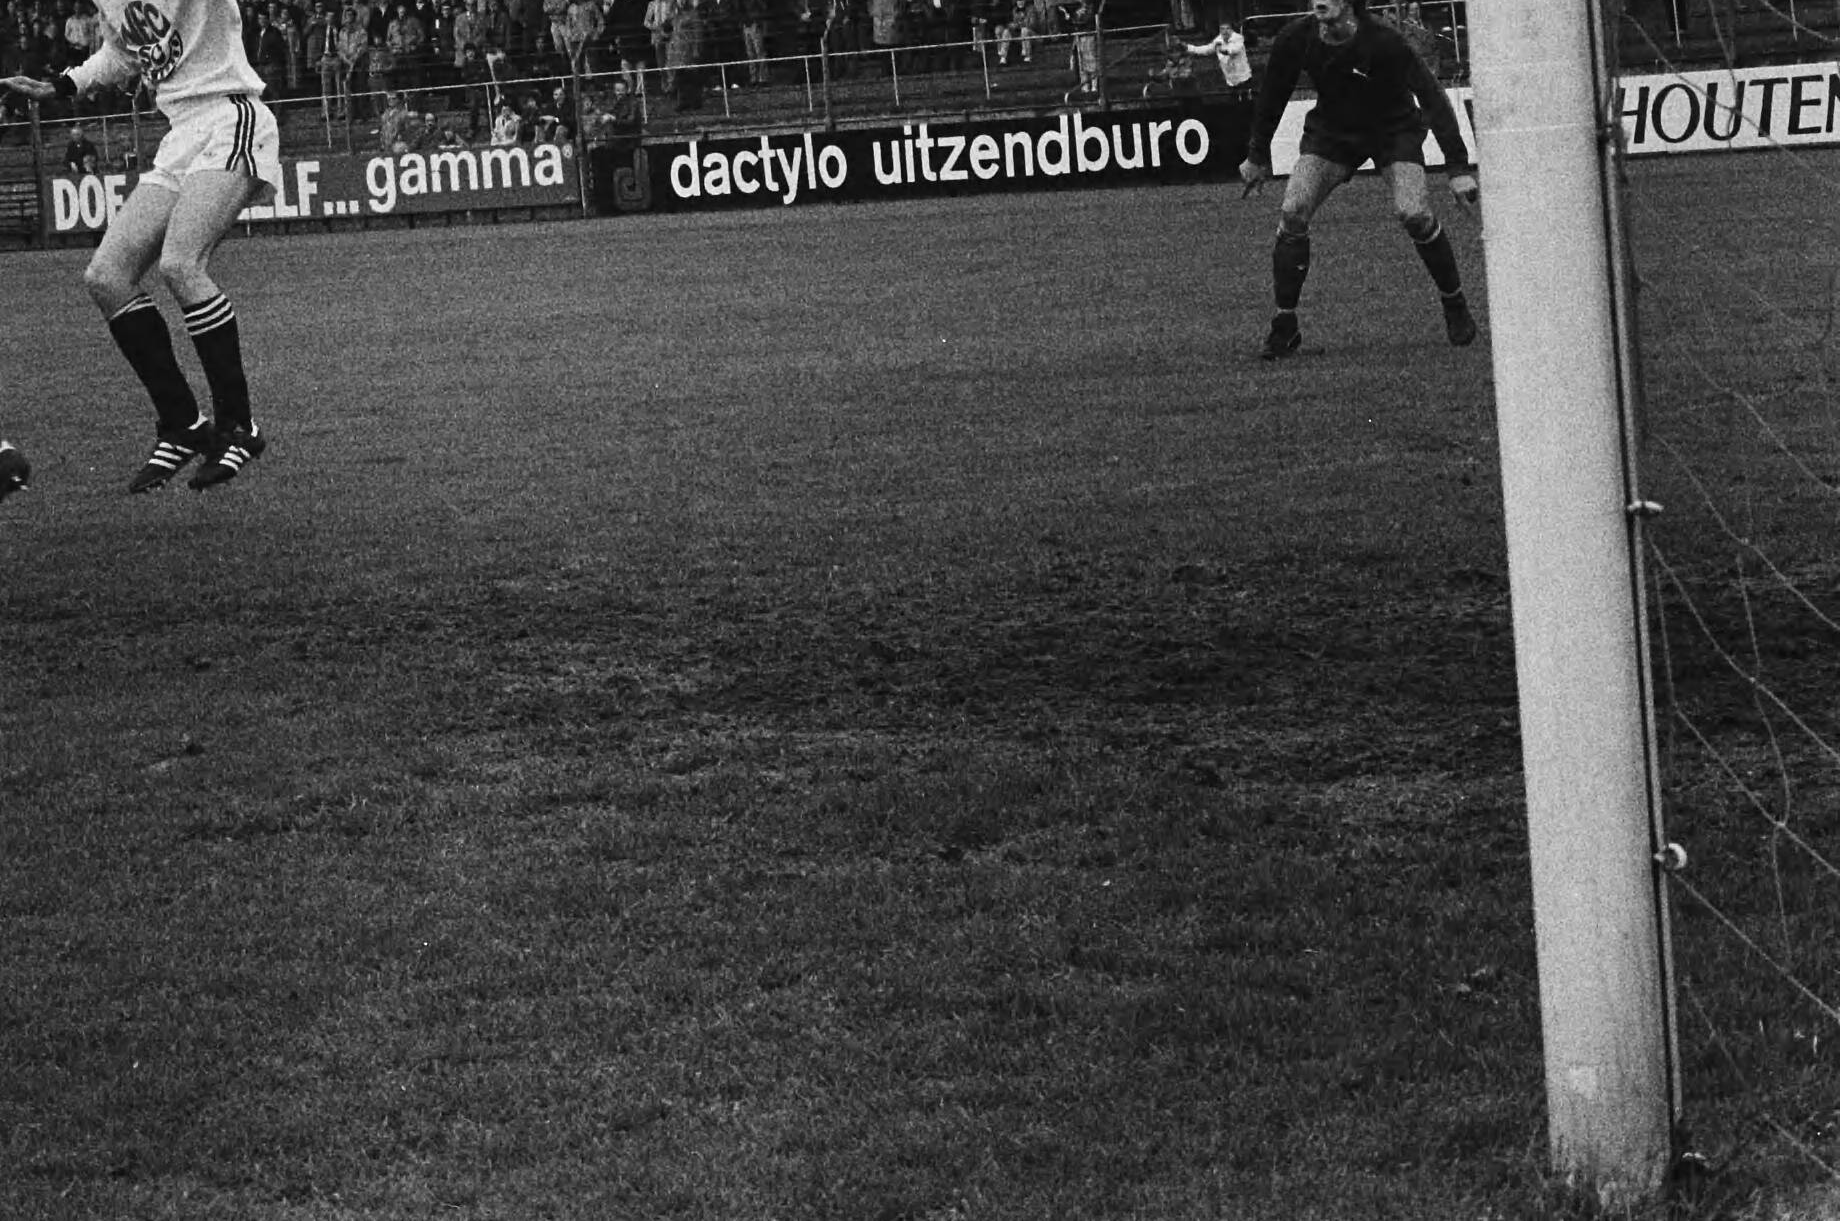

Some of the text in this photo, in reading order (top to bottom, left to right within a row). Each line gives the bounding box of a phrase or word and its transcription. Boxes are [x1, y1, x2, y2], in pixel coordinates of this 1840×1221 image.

[365, 143, 564, 211] gamma
[670, 114, 1209, 205] dactylo uitzendburo
